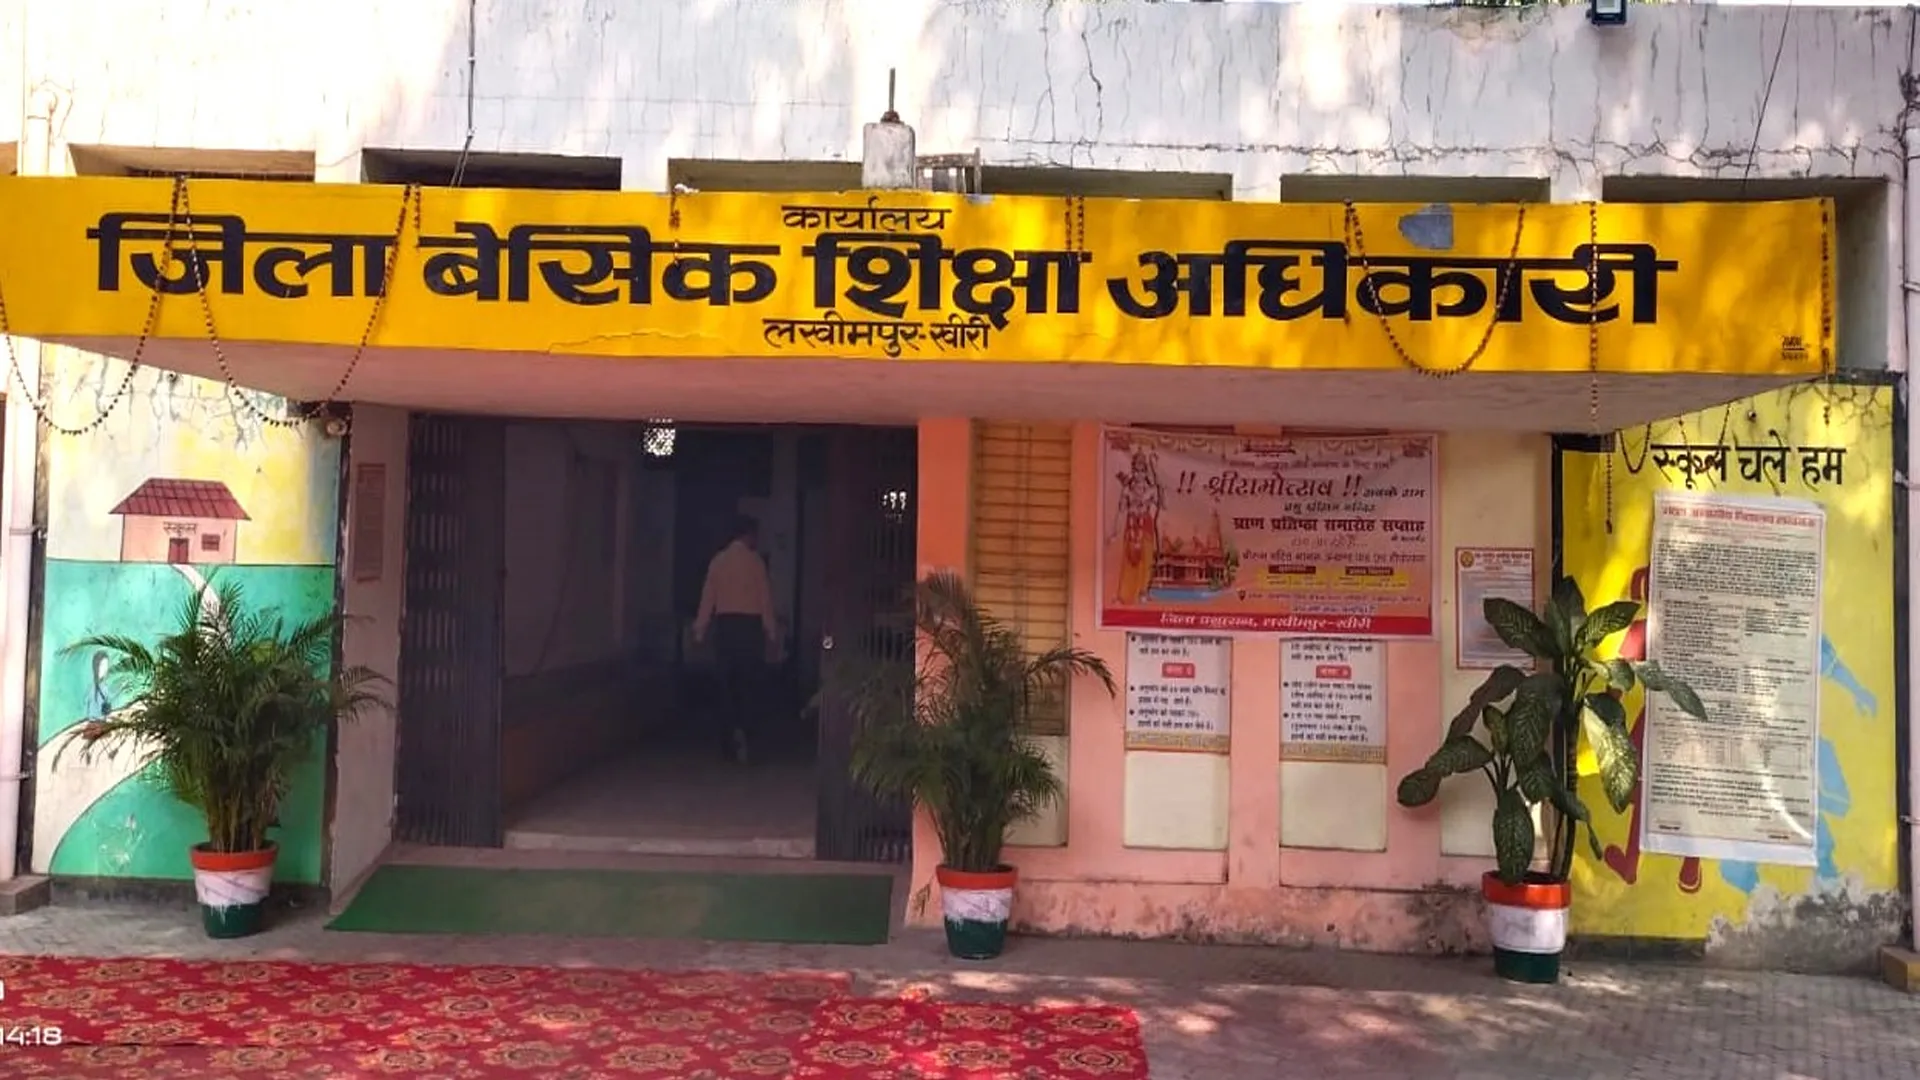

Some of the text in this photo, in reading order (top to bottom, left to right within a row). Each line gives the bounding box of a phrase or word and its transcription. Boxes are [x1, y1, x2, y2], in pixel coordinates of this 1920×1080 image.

[781, 196, 952, 232] कार्यालय
[86, 212, 1678, 331] जिला बेसिक शिक्षा अधिकारी
[763, 310, 991, 357] लखीमपुर-खीरी
[1651, 430, 1847, 496] स्कूल चले हम
[1233, 515, 1426, 533] प्राण प्रतिष्ठा समारोह सप्ताह
